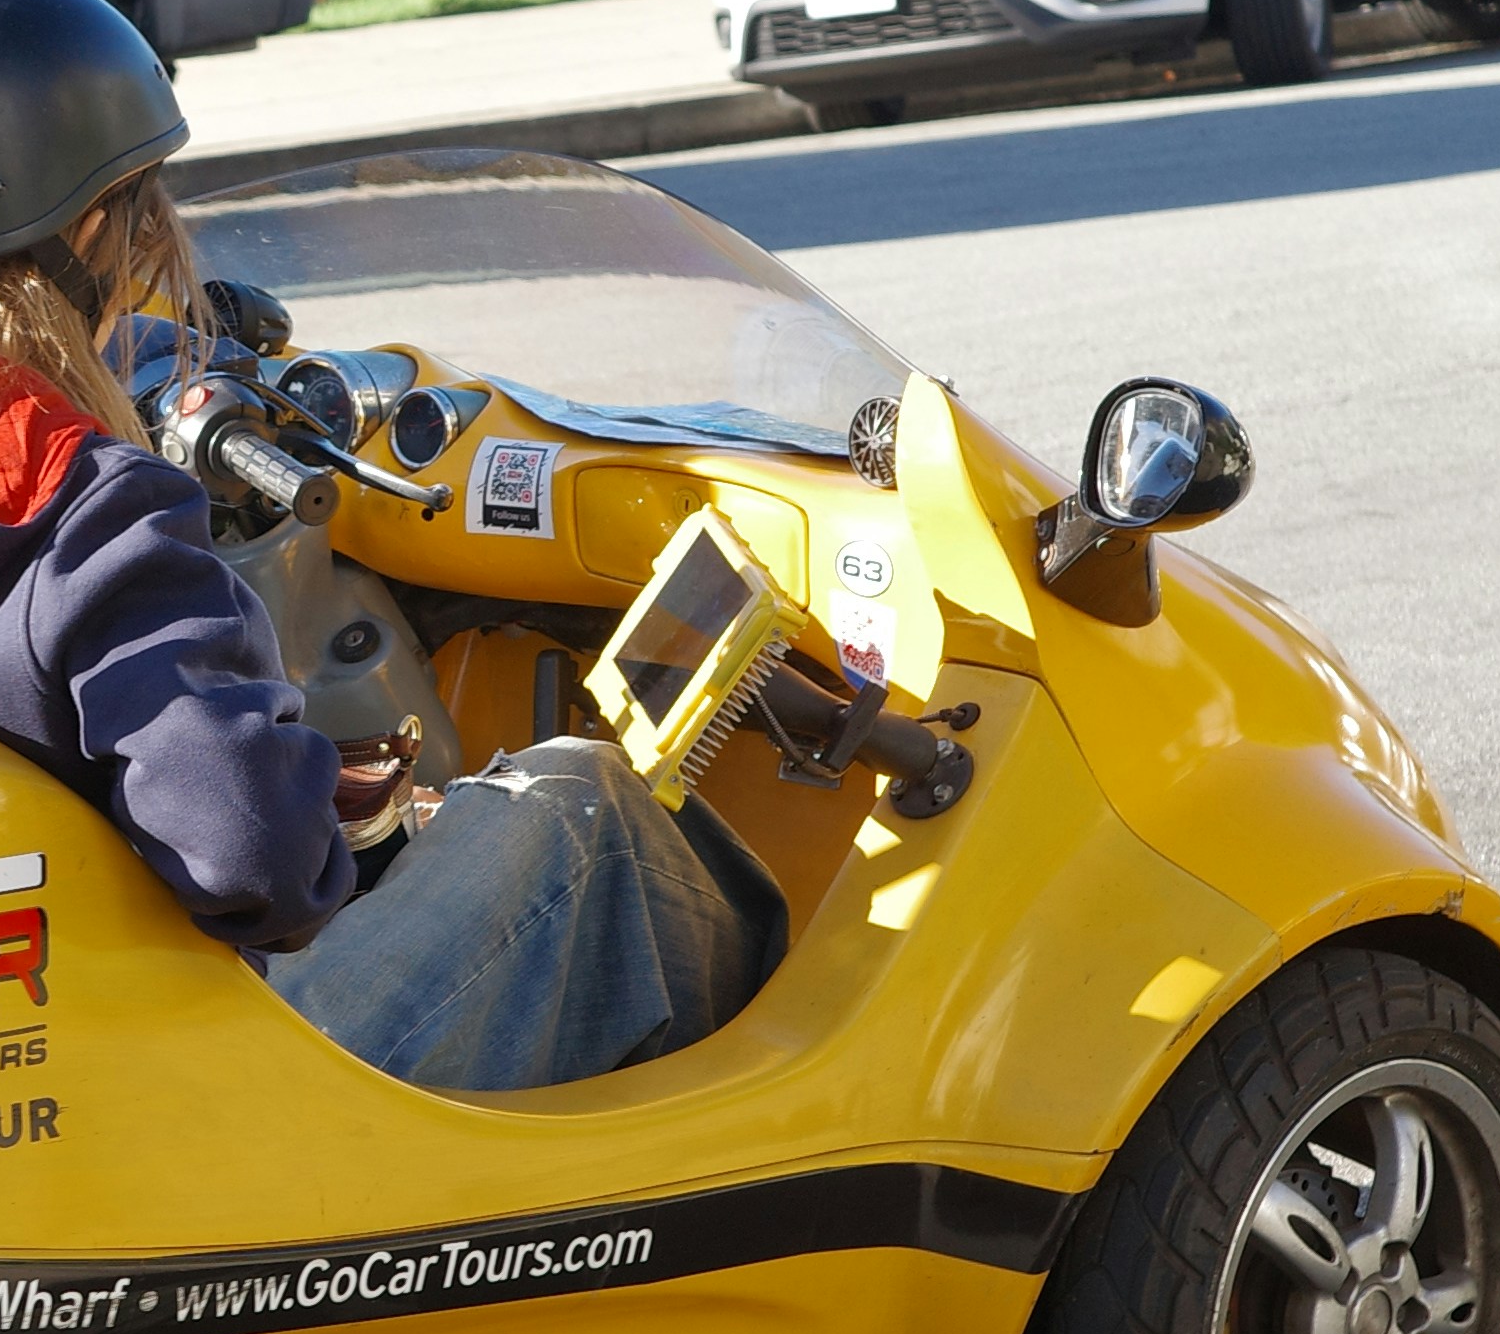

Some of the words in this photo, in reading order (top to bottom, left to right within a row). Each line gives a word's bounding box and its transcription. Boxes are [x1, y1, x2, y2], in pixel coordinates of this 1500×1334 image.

[492, 510, 519, 521] Follow
[521, 514, 531, 522] us
[842, 555, 883, 582] 63
[174, 1226, 654, 1323] www.GoCarTours.com
